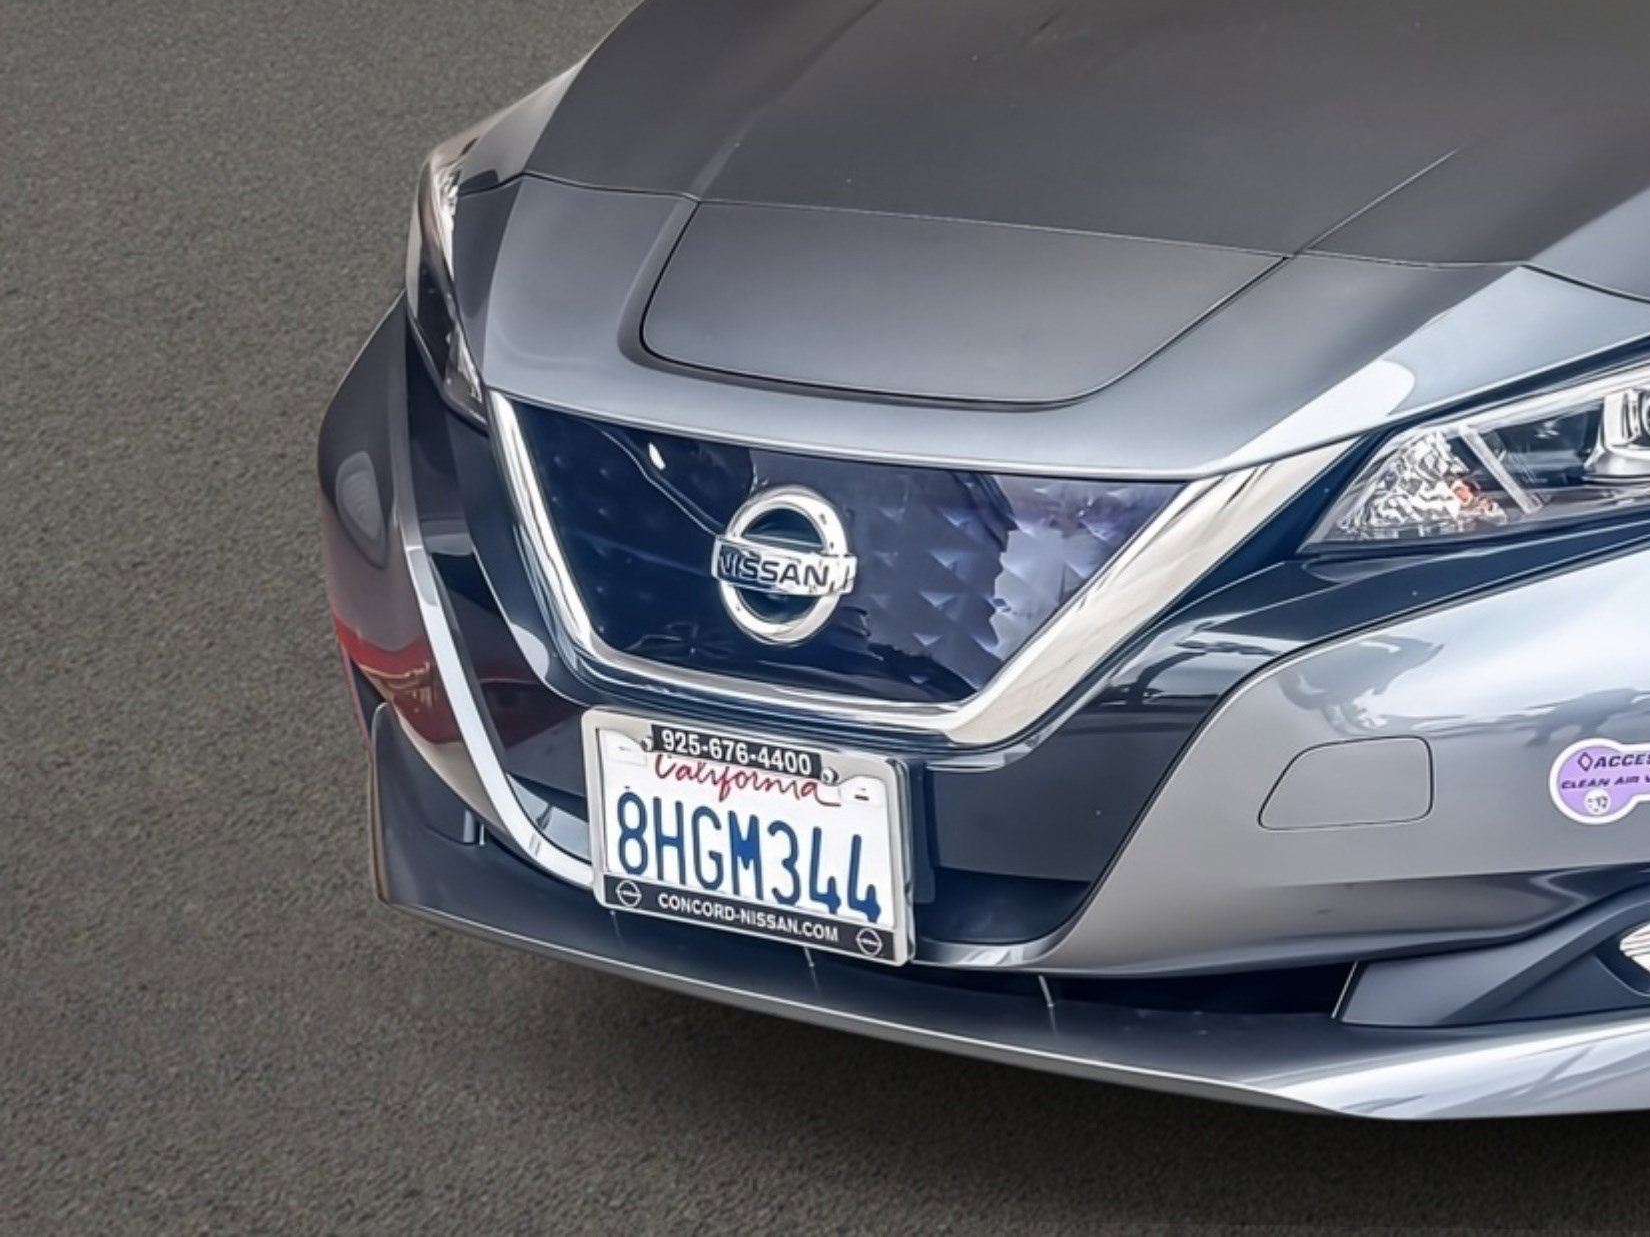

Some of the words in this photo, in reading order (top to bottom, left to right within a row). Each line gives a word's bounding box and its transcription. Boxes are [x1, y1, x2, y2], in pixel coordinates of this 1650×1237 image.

[718, 547, 830, 588] NISSAN
[661, 729, 813, 776] 925-676-4400
[654, 754, 841, 808] California
[1560, 778, 1610, 789] CLEAN
[1614, 775, 1639, 786] AIR
[616, 791, 881, 922] 8HGM344
[657, 893, 839, 942] CONCORD-NISSAN.COM
